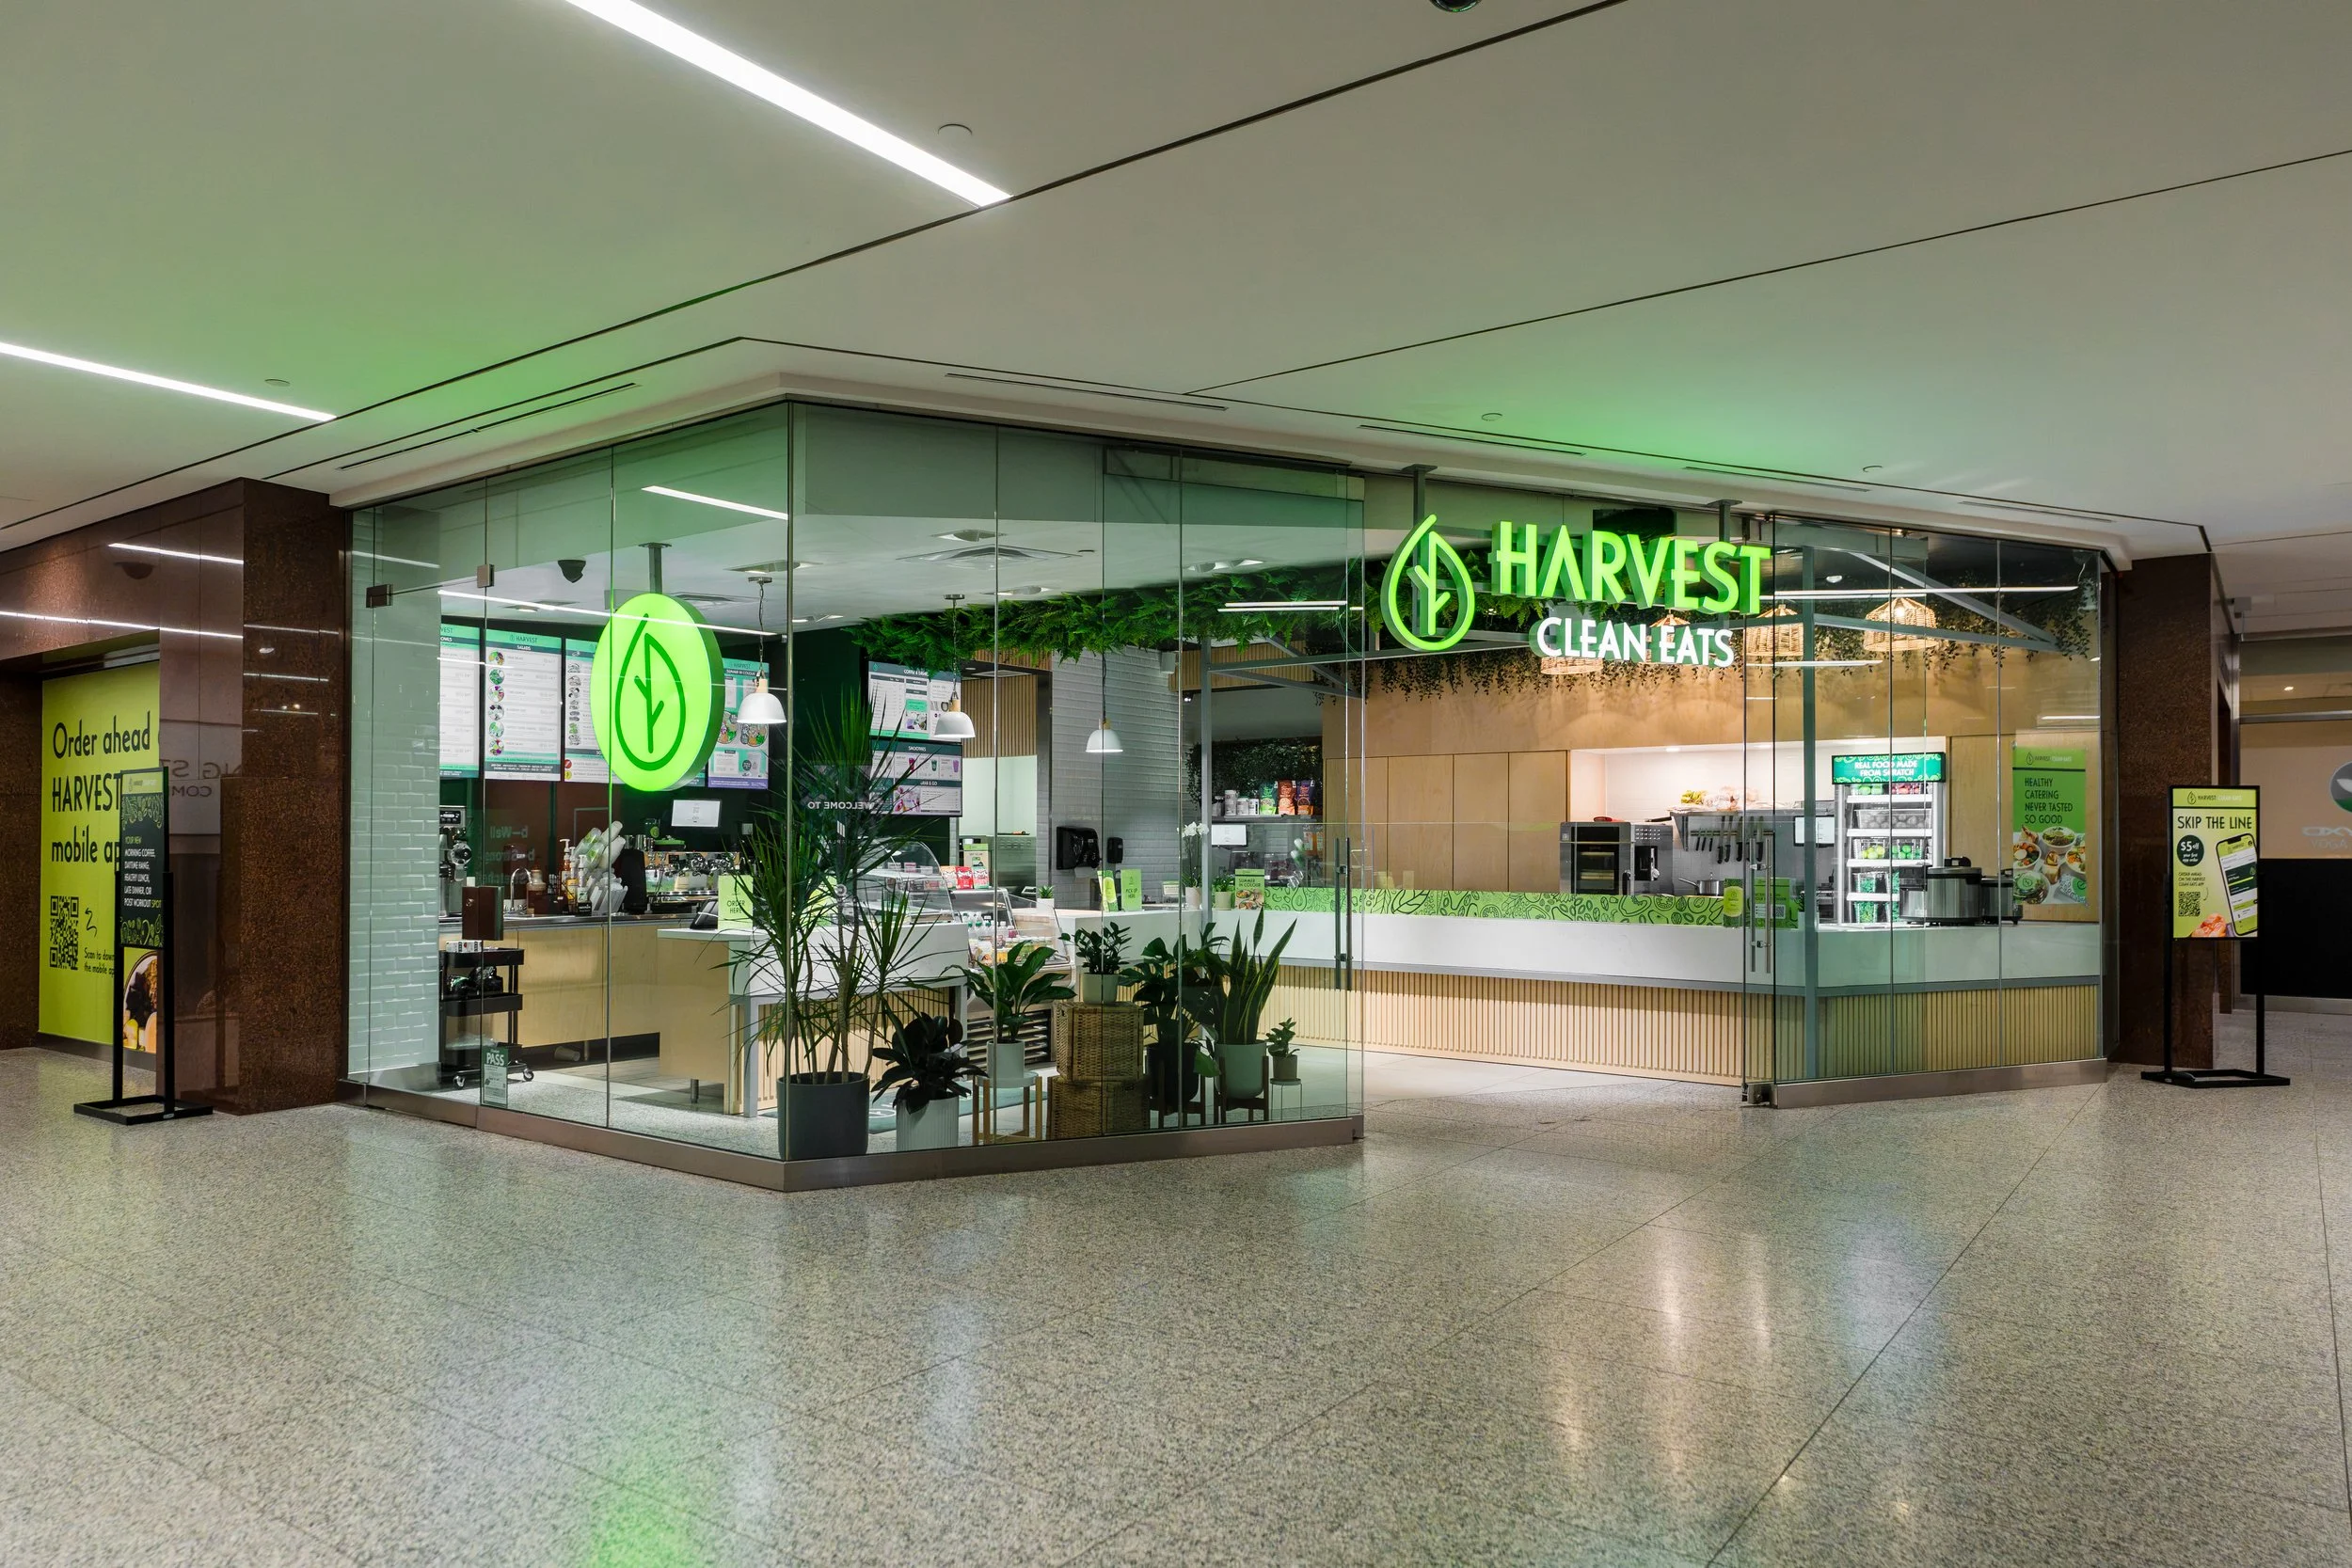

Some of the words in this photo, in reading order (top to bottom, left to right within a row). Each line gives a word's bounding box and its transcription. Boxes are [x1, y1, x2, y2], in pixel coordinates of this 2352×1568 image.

[1490, 520, 1771, 615] HARVEST
[1534, 616, 1646, 662] CLEAN
[1658, 625, 1734, 668] EATS
[53, 719, 97, 759] Order
[103, 710, 151, 754] ahead
[1854, 761, 1871, 769] REAL
[1872, 760, 1894, 769] FOOD
[1897, 760, 1917, 768] MADE
[2025, 777, 2053, 787] HEALTHY
[52, 772, 120, 812] HARVEST
[2025, 790, 2059, 799] CATERING
[2025, 802, 2047, 812] NEVER
[2049, 802, 2073, 812] TASTED
[2025, 814, 2036, 824] SO
[2039, 815, 2063, 824] GOOD
[2177, 816, 2201, 829] SKIP
[2206, 816, 2225, 829] THE
[2229, 816, 2252, 829] LINE
[51, 825, 97, 863] mobile
[2181, 841, 2193, 851] $5
[125, 848, 141, 857] MORNING
[151, 900, 162, 908] SPOT
[84, 947, 95, 960] Scan
[96, 950, 101, 960] to
[92, 962, 107, 974] mobile
[486, 1052, 505, 1066] PASS
